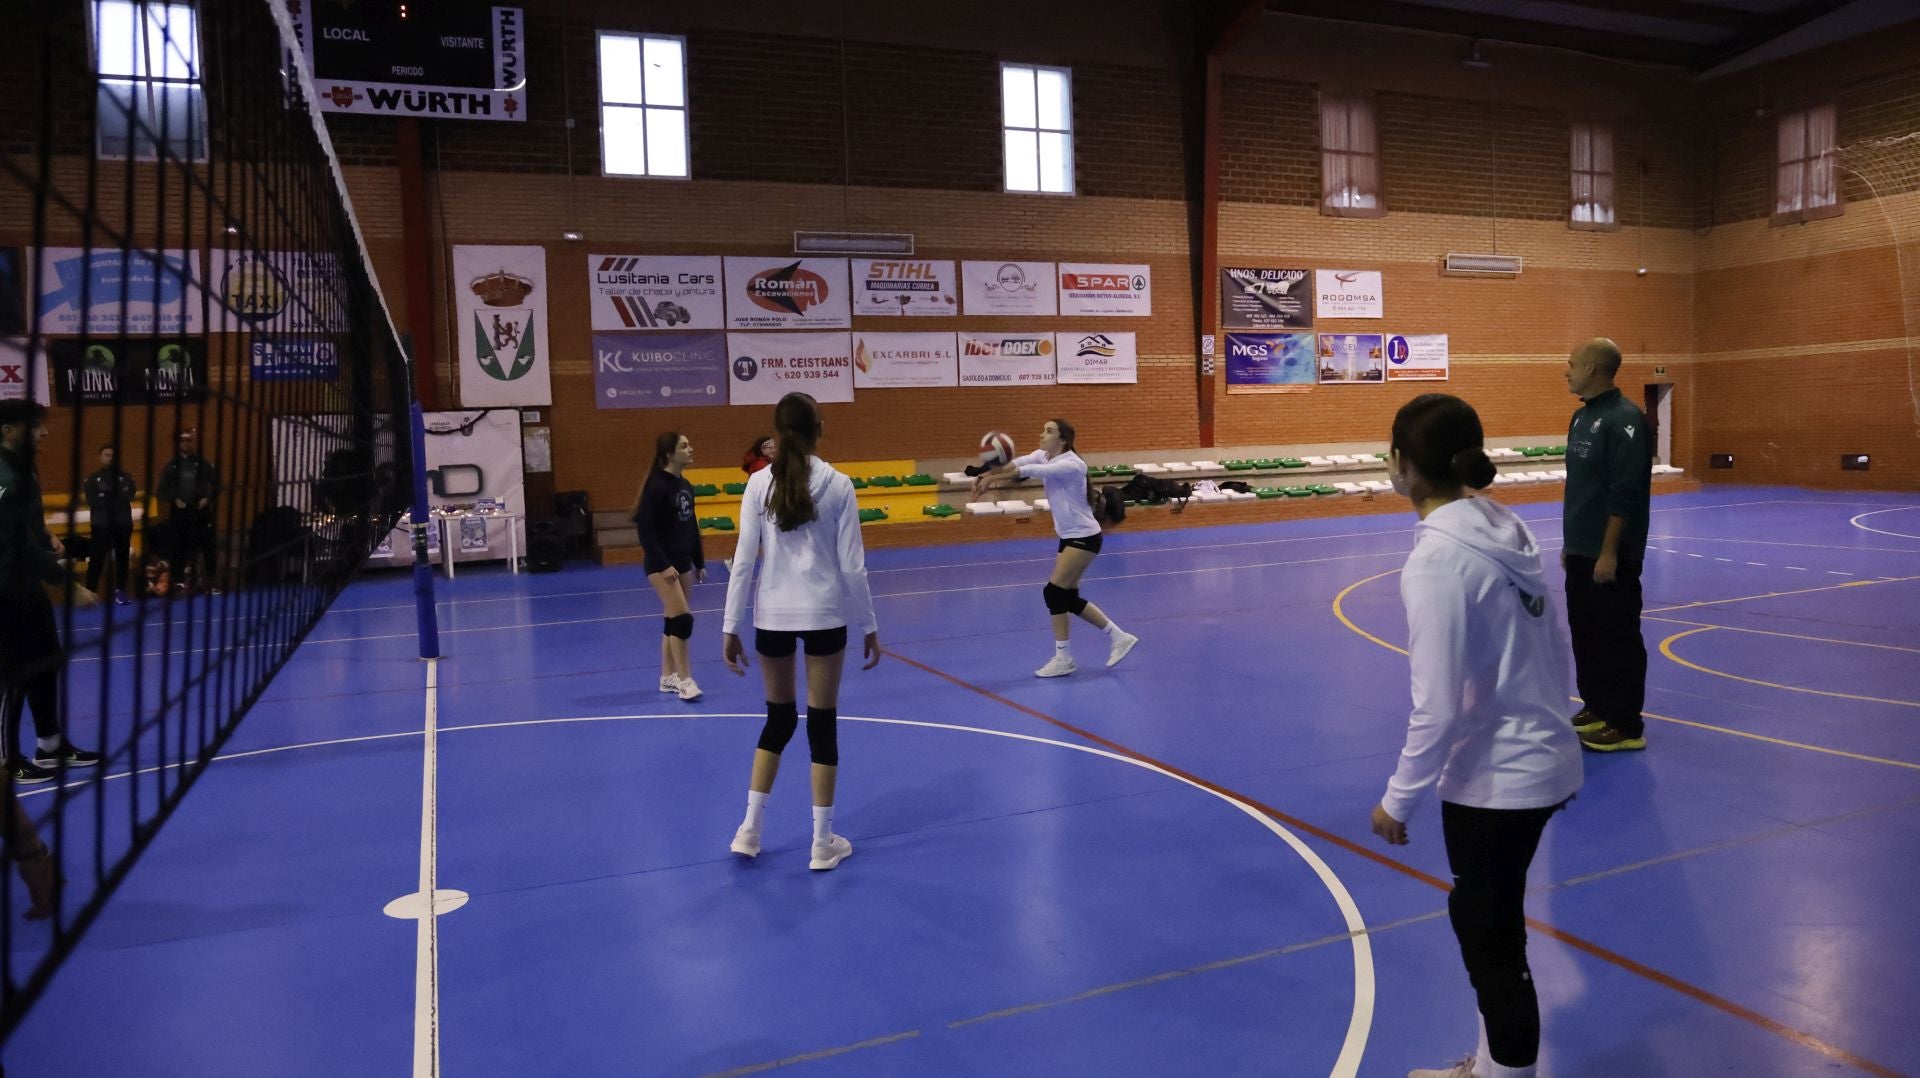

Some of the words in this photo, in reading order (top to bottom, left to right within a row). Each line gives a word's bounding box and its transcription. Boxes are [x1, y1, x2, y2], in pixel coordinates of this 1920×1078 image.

[323, 27, 370, 41] LOCAL
[440, 36, 484, 48] VISITANTE
[391, 65, 424, 77] PERIODO
[365, 87, 491, 116] WÜRTH
[868, 262, 937, 279] STIHL
[1260, 270, 1304, 280] DELICADO
[597, 272, 670, 285] Lusitania
[678, 273, 714, 285] Cars
[755, 277, 816, 289] Román
[1077, 276, 1129, 288] SPAR
[598, 287, 626, 296] Taller
[628, 287, 641, 296] de
[674, 288, 681, 297] y
[682, 287, 715, 297] pintura
[871, 282, 911, 290] MAQUINARIAS
[1322, 294, 1376, 302] ROGOMSA
[872, 350, 930, 359] EXCARBRI
[1232, 344, 1268, 356] MGS
[598, 349, 633, 373] KC
[761, 357, 787, 369] FRM.
[789, 356, 849, 368] CEISTRANS
[1084, 358, 1108, 366] DIMAR
[784, 371, 801, 379] 620
[803, 370, 820, 379] 939
[823, 370, 839, 378] 544
